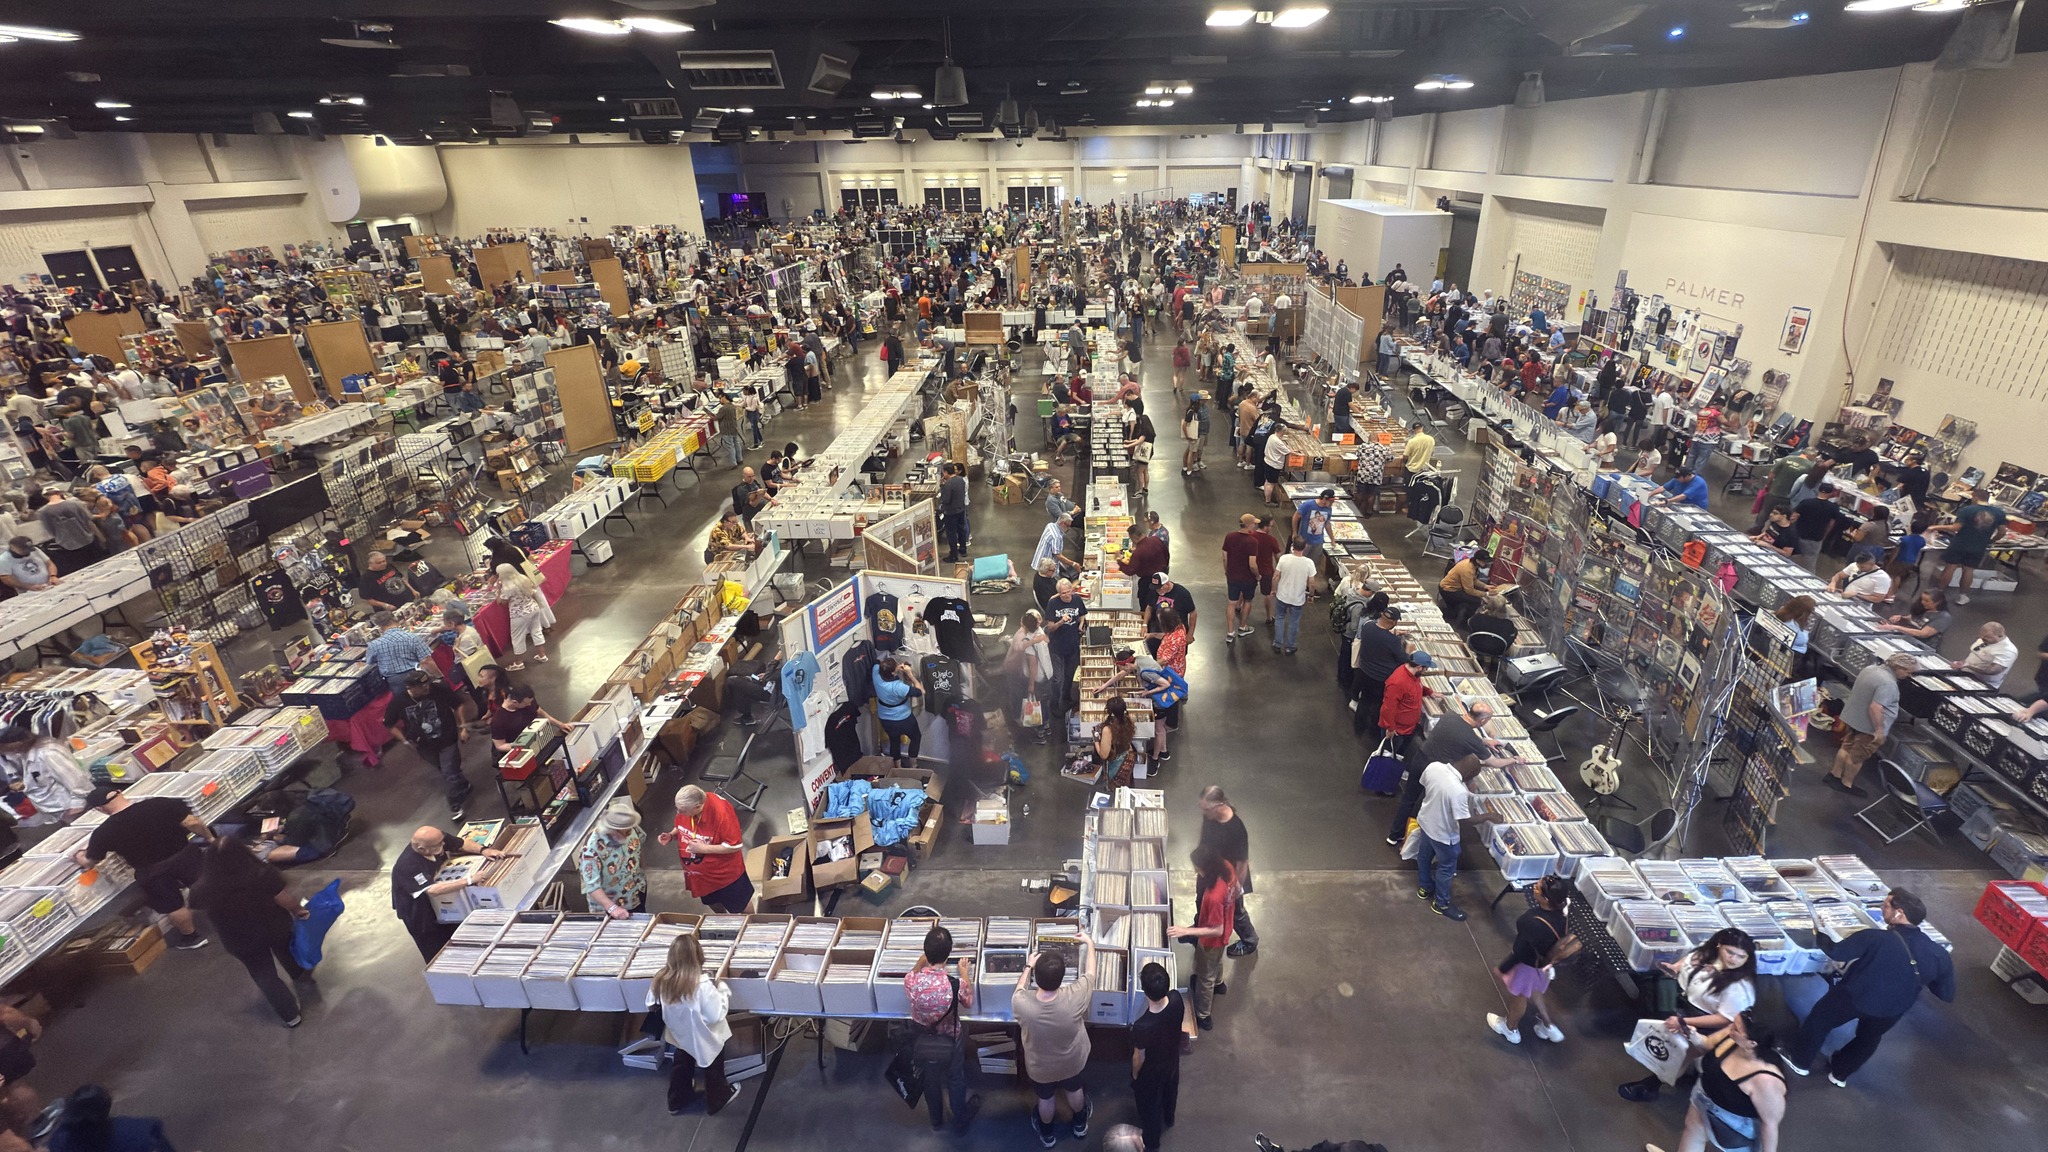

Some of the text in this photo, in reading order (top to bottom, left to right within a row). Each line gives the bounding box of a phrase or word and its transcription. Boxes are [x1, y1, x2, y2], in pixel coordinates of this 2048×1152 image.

[1665, 277, 1745, 309] PALMER
[817, 618, 832, 631] VINYL
[832, 601, 855, 620] RECORDS
